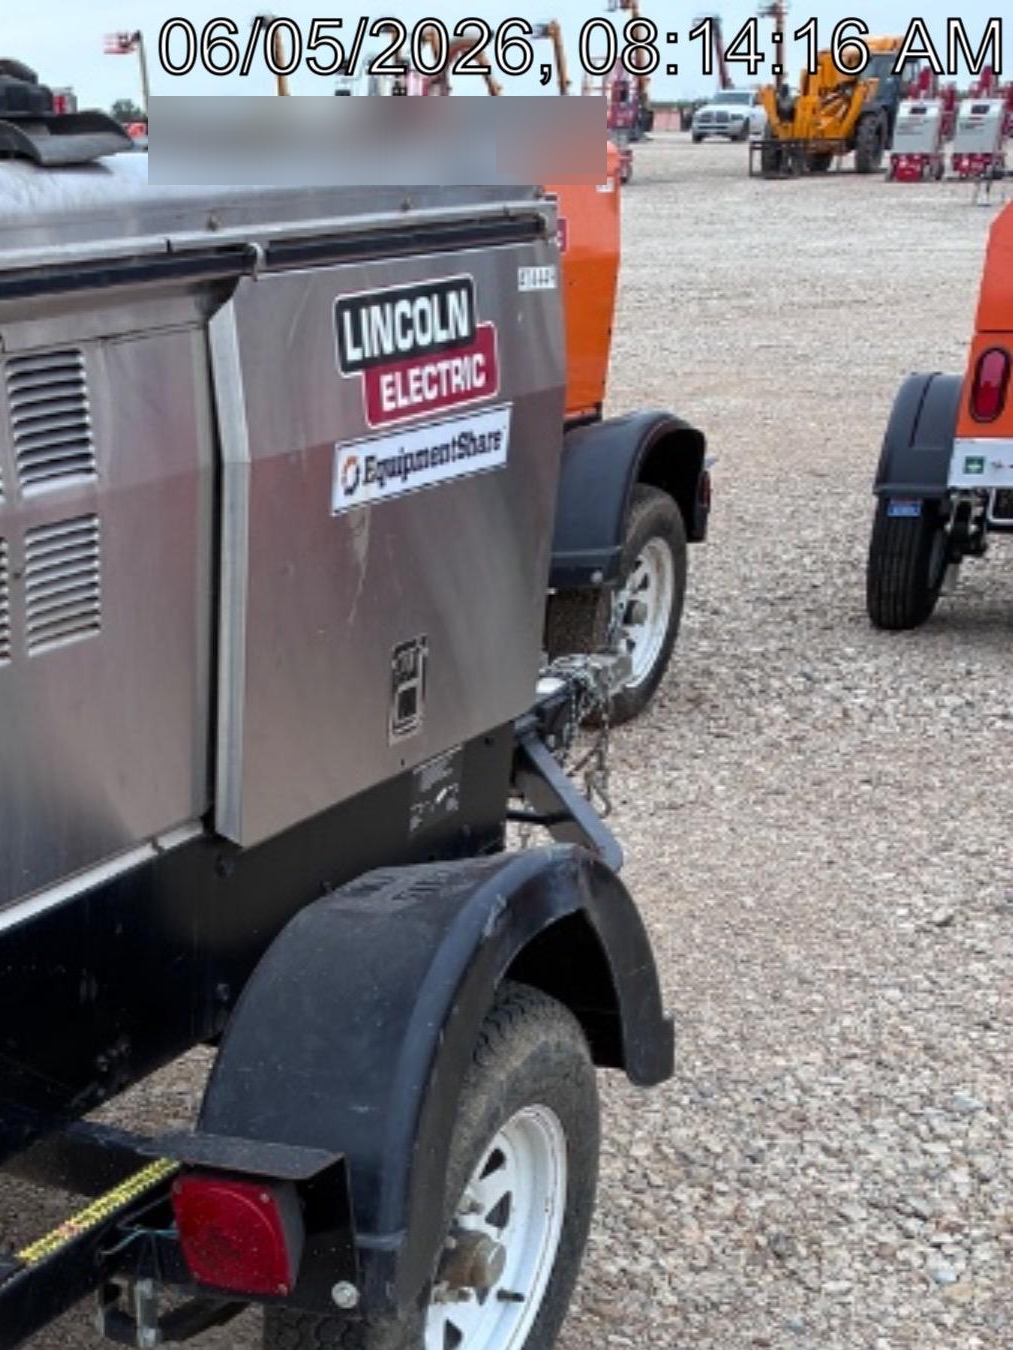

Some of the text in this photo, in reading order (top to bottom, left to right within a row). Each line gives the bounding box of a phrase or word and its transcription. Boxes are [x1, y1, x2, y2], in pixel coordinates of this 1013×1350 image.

[343, 289, 469, 361] LINCOLN
[380, 354, 486, 411] ELECTRIC
[363, 430, 502, 488] EquipmentShare
